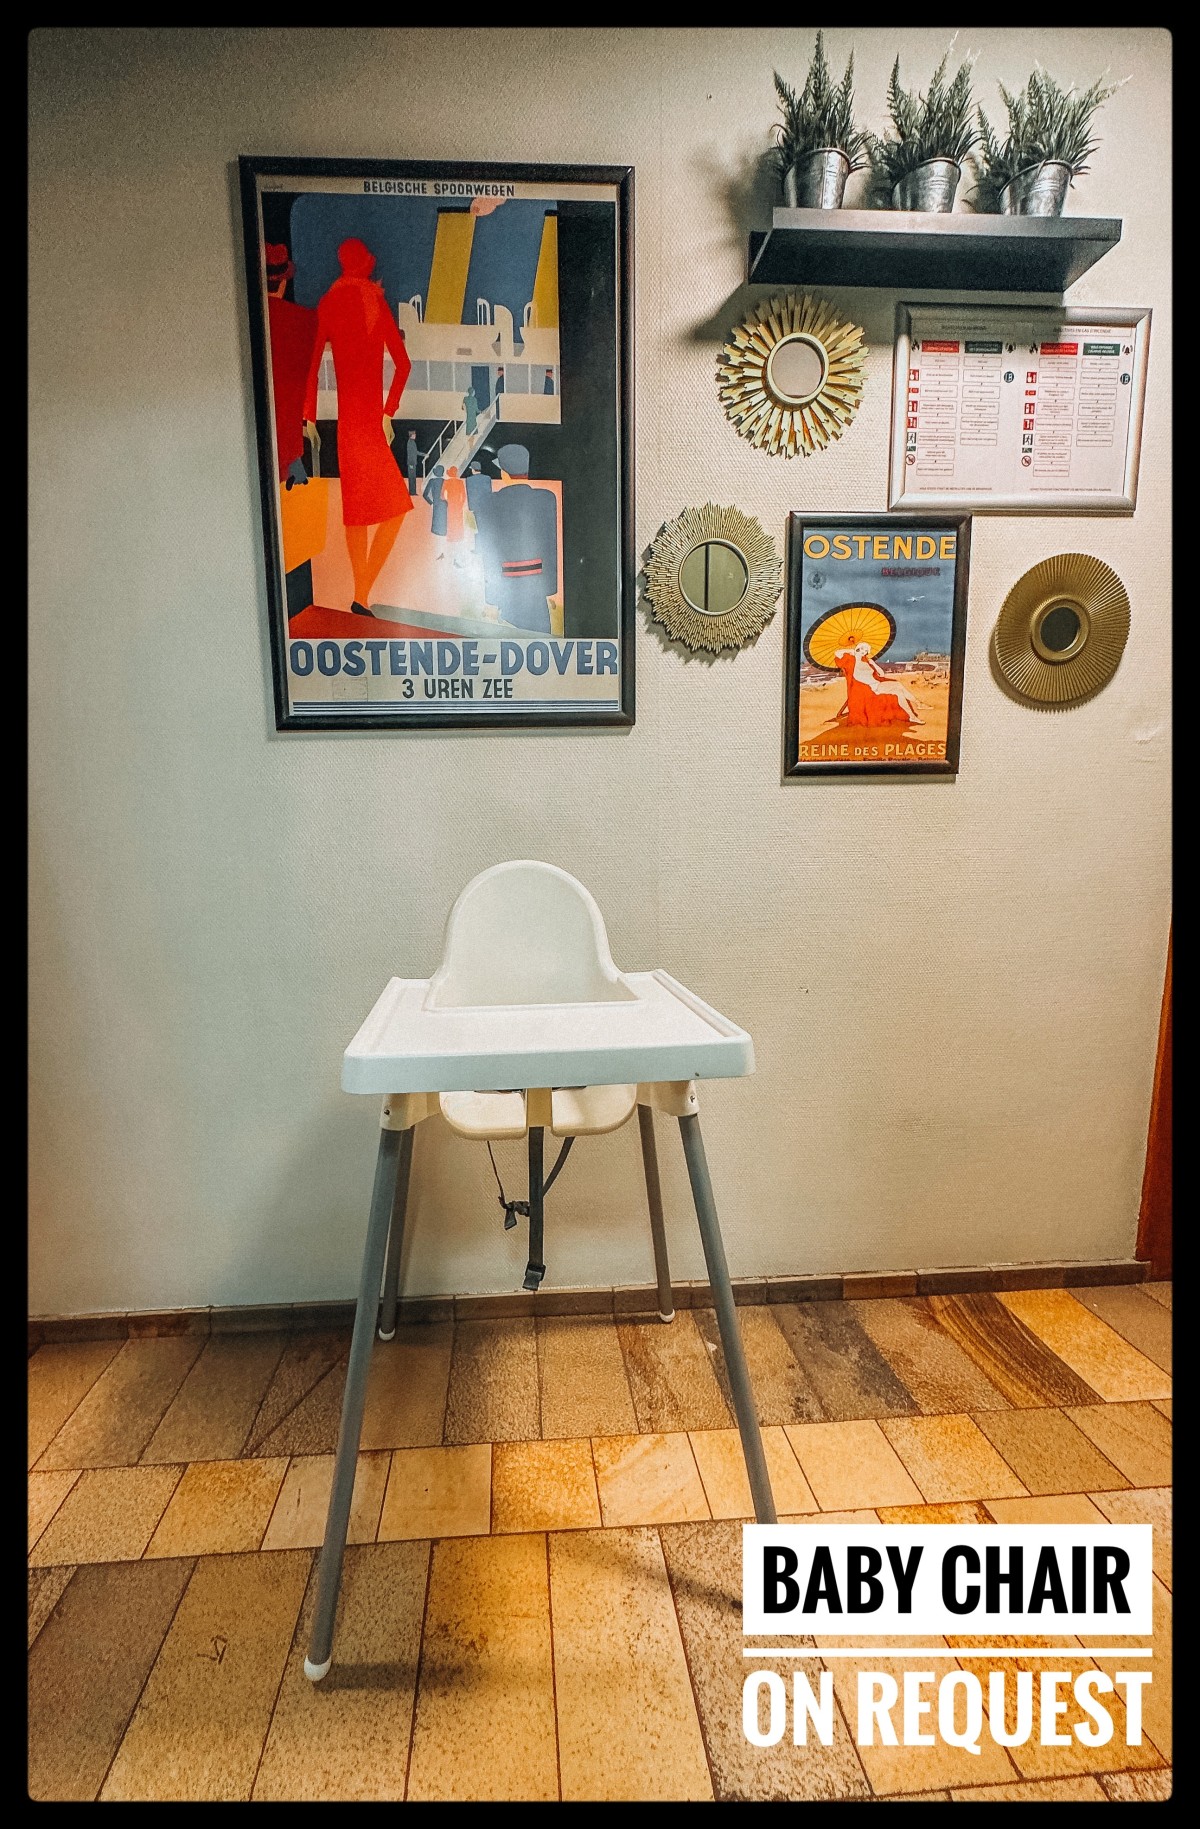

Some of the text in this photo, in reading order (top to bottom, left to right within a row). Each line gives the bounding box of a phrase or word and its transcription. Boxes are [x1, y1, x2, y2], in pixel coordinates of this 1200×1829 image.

[363, 181, 515, 197] BELGISCHE SPOORWEGEN
[803, 534, 957, 561] OSTENDE
[289, 640, 618, 676] OOSTENDE-DOVER
[402, 678, 513, 699] 3 UREN ZEE
[799, 743, 946, 757] REINE DES PLAGES
